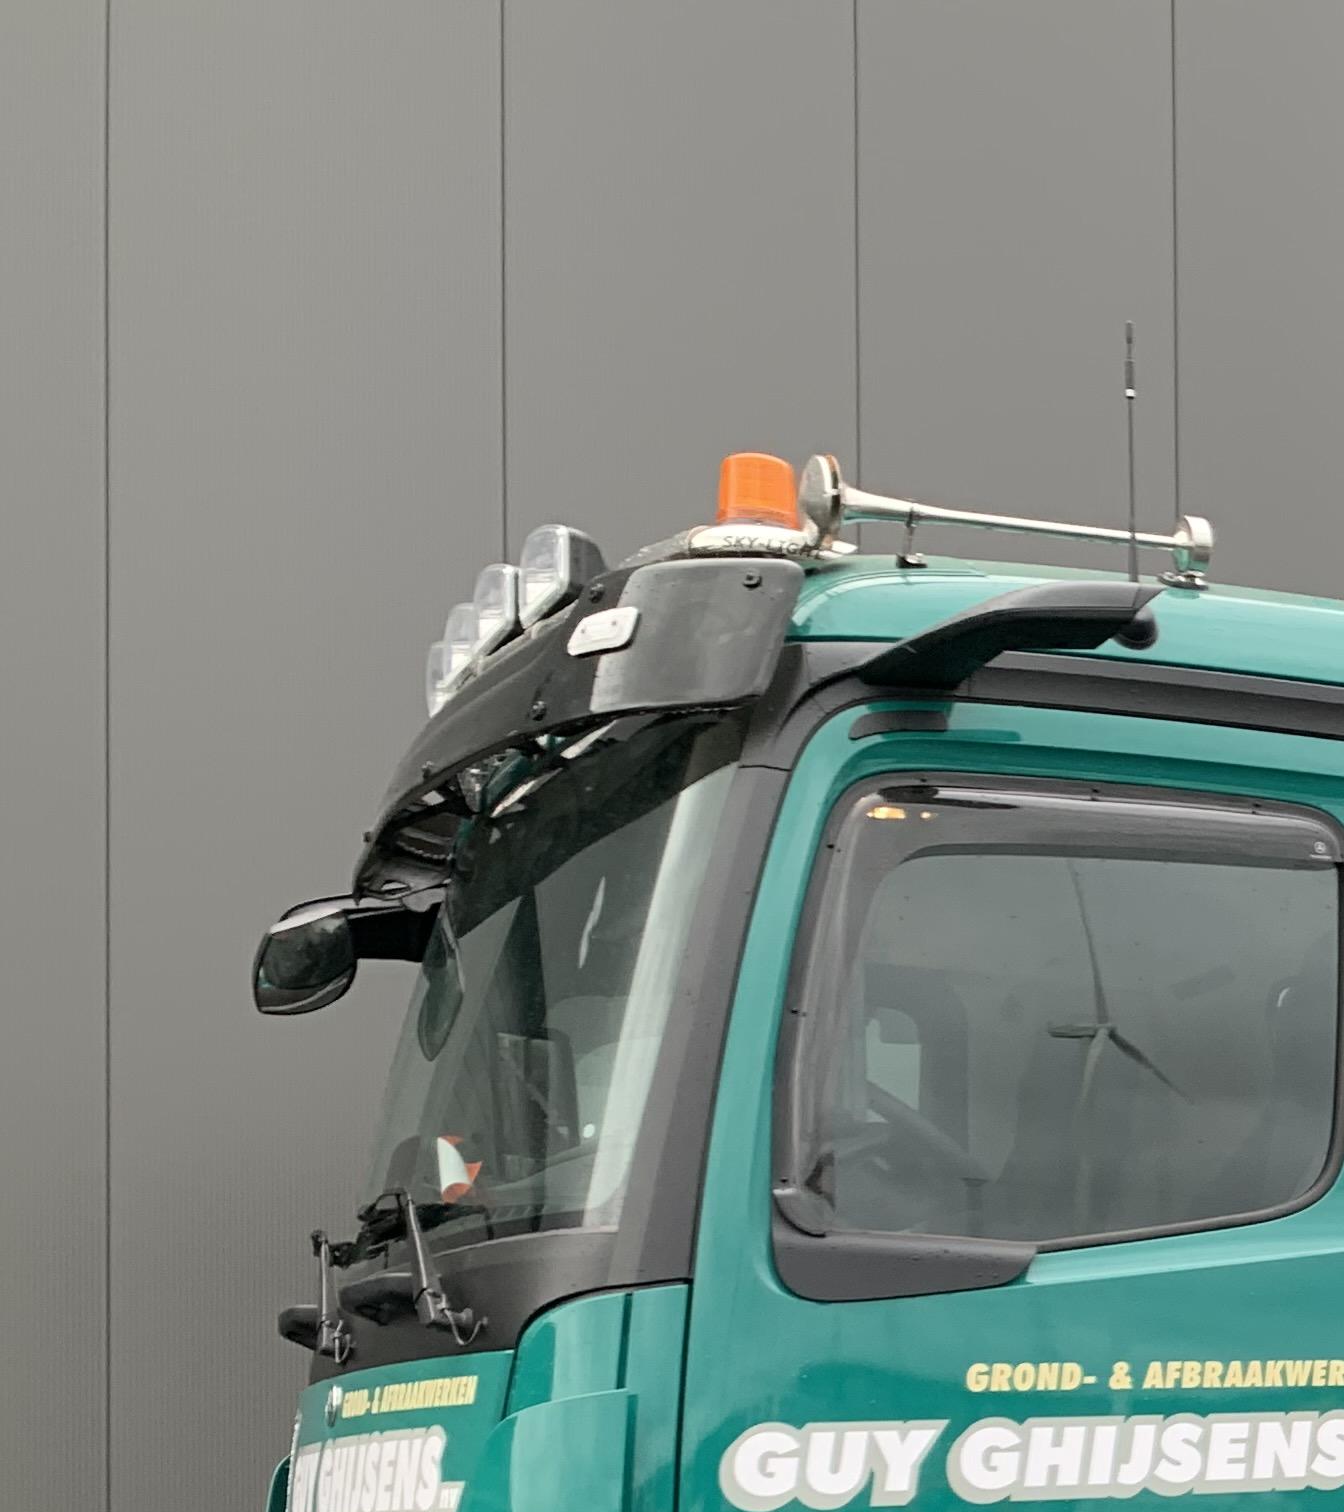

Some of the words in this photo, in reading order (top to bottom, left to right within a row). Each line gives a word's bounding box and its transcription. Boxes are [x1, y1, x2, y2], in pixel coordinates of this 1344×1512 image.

[966, 1361, 1096, 1393] GROND-
[1108, 1360, 1133, 1390] &
[723, 1422, 946, 1508] GUY
